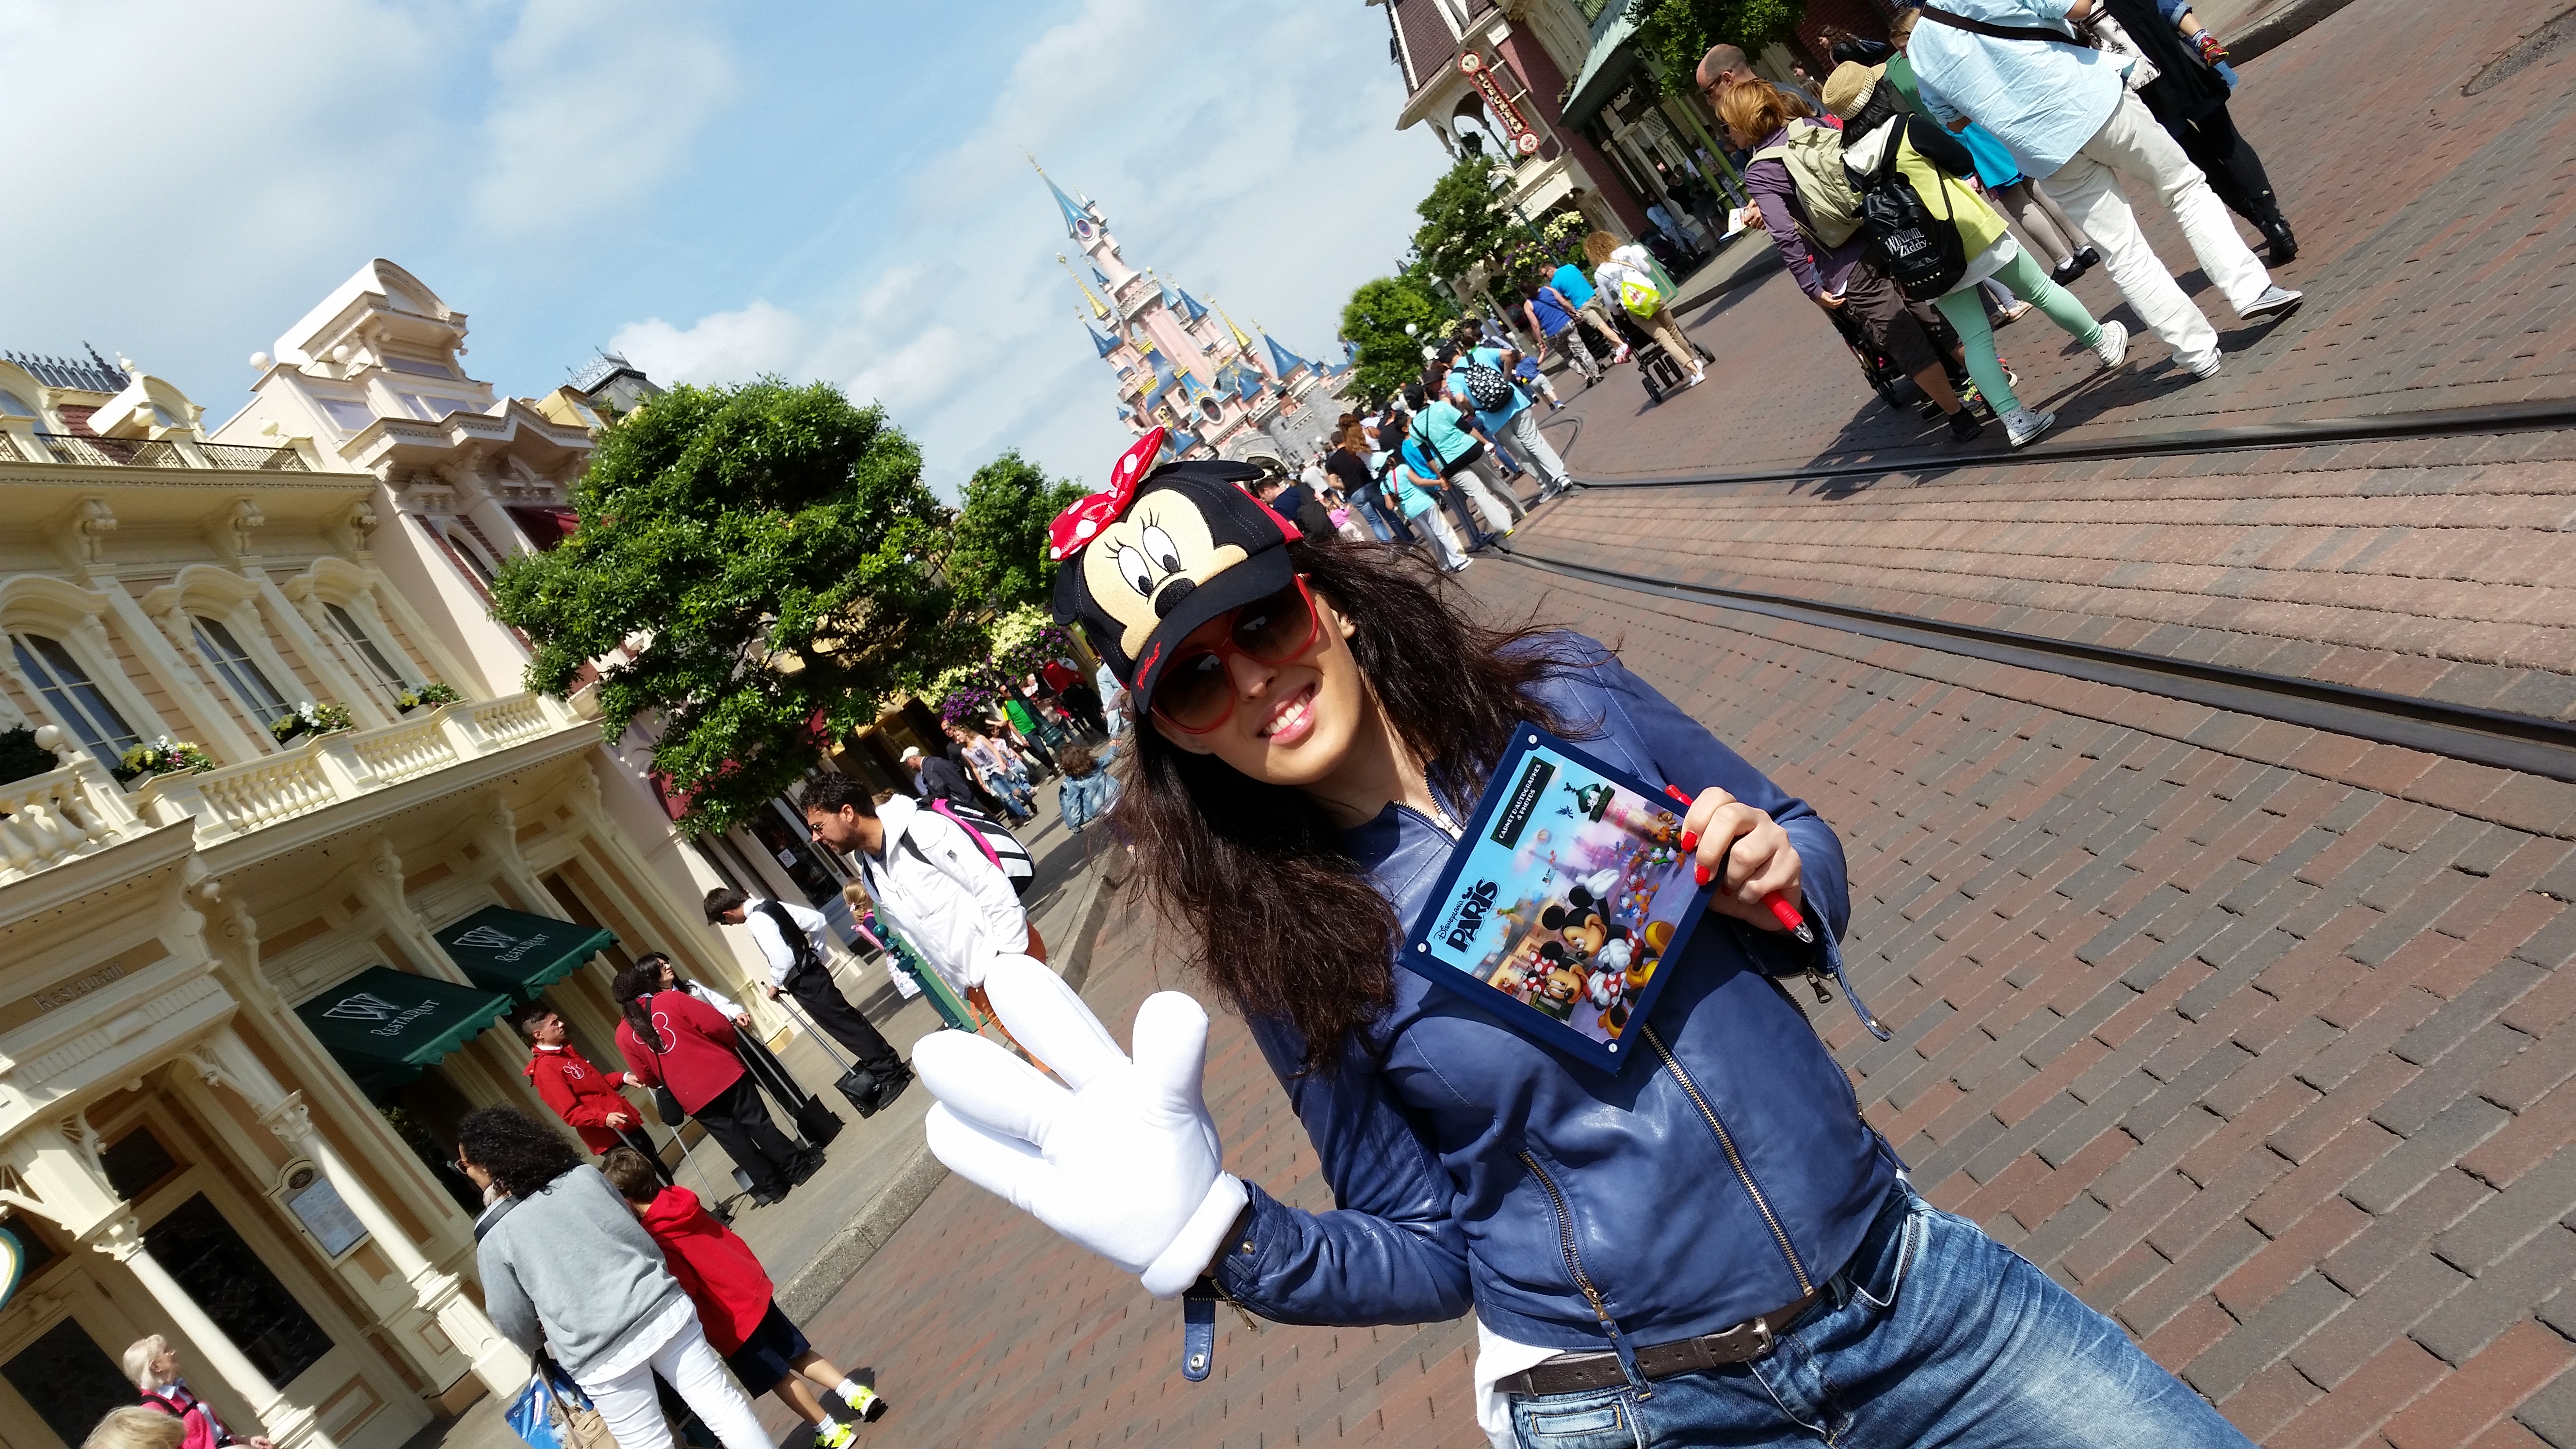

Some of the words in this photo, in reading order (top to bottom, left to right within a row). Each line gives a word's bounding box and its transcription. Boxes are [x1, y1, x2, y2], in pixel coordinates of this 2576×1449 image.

[1499, 814, 1515, 839] CARNET
[1512, 763, 1542, 815] D'AUTOGRAPHES
[1519, 789, 1536, 815] PHOTOS
[1446, 878, 1498, 953] PARIS
[32, 962, 127, 1012] Restaurant
[370, 999, 440, 1037] RESTAURANT
